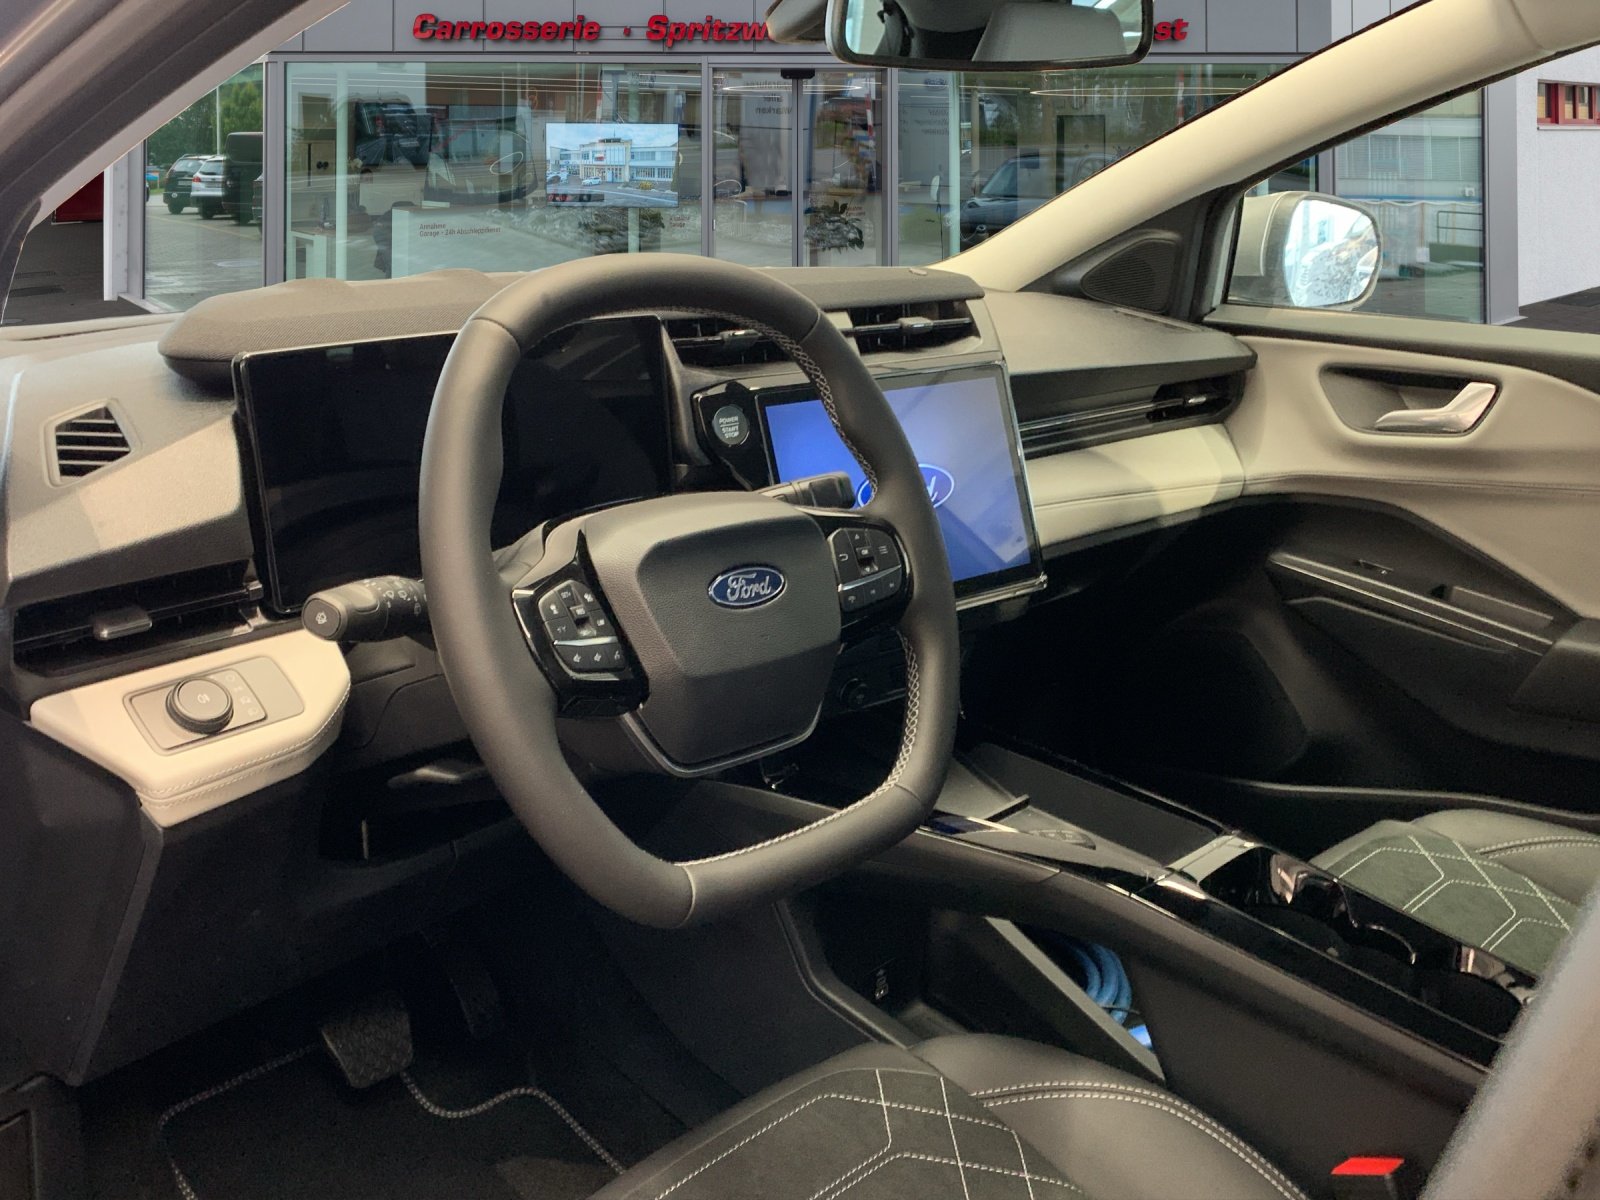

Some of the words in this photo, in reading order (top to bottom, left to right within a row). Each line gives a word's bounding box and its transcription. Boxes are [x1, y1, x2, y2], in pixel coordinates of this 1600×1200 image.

[412, 13, 601, 41] Carrosserie
[725, 431, 739, 439] STOP
[726, 572, 772, 602] Ford
